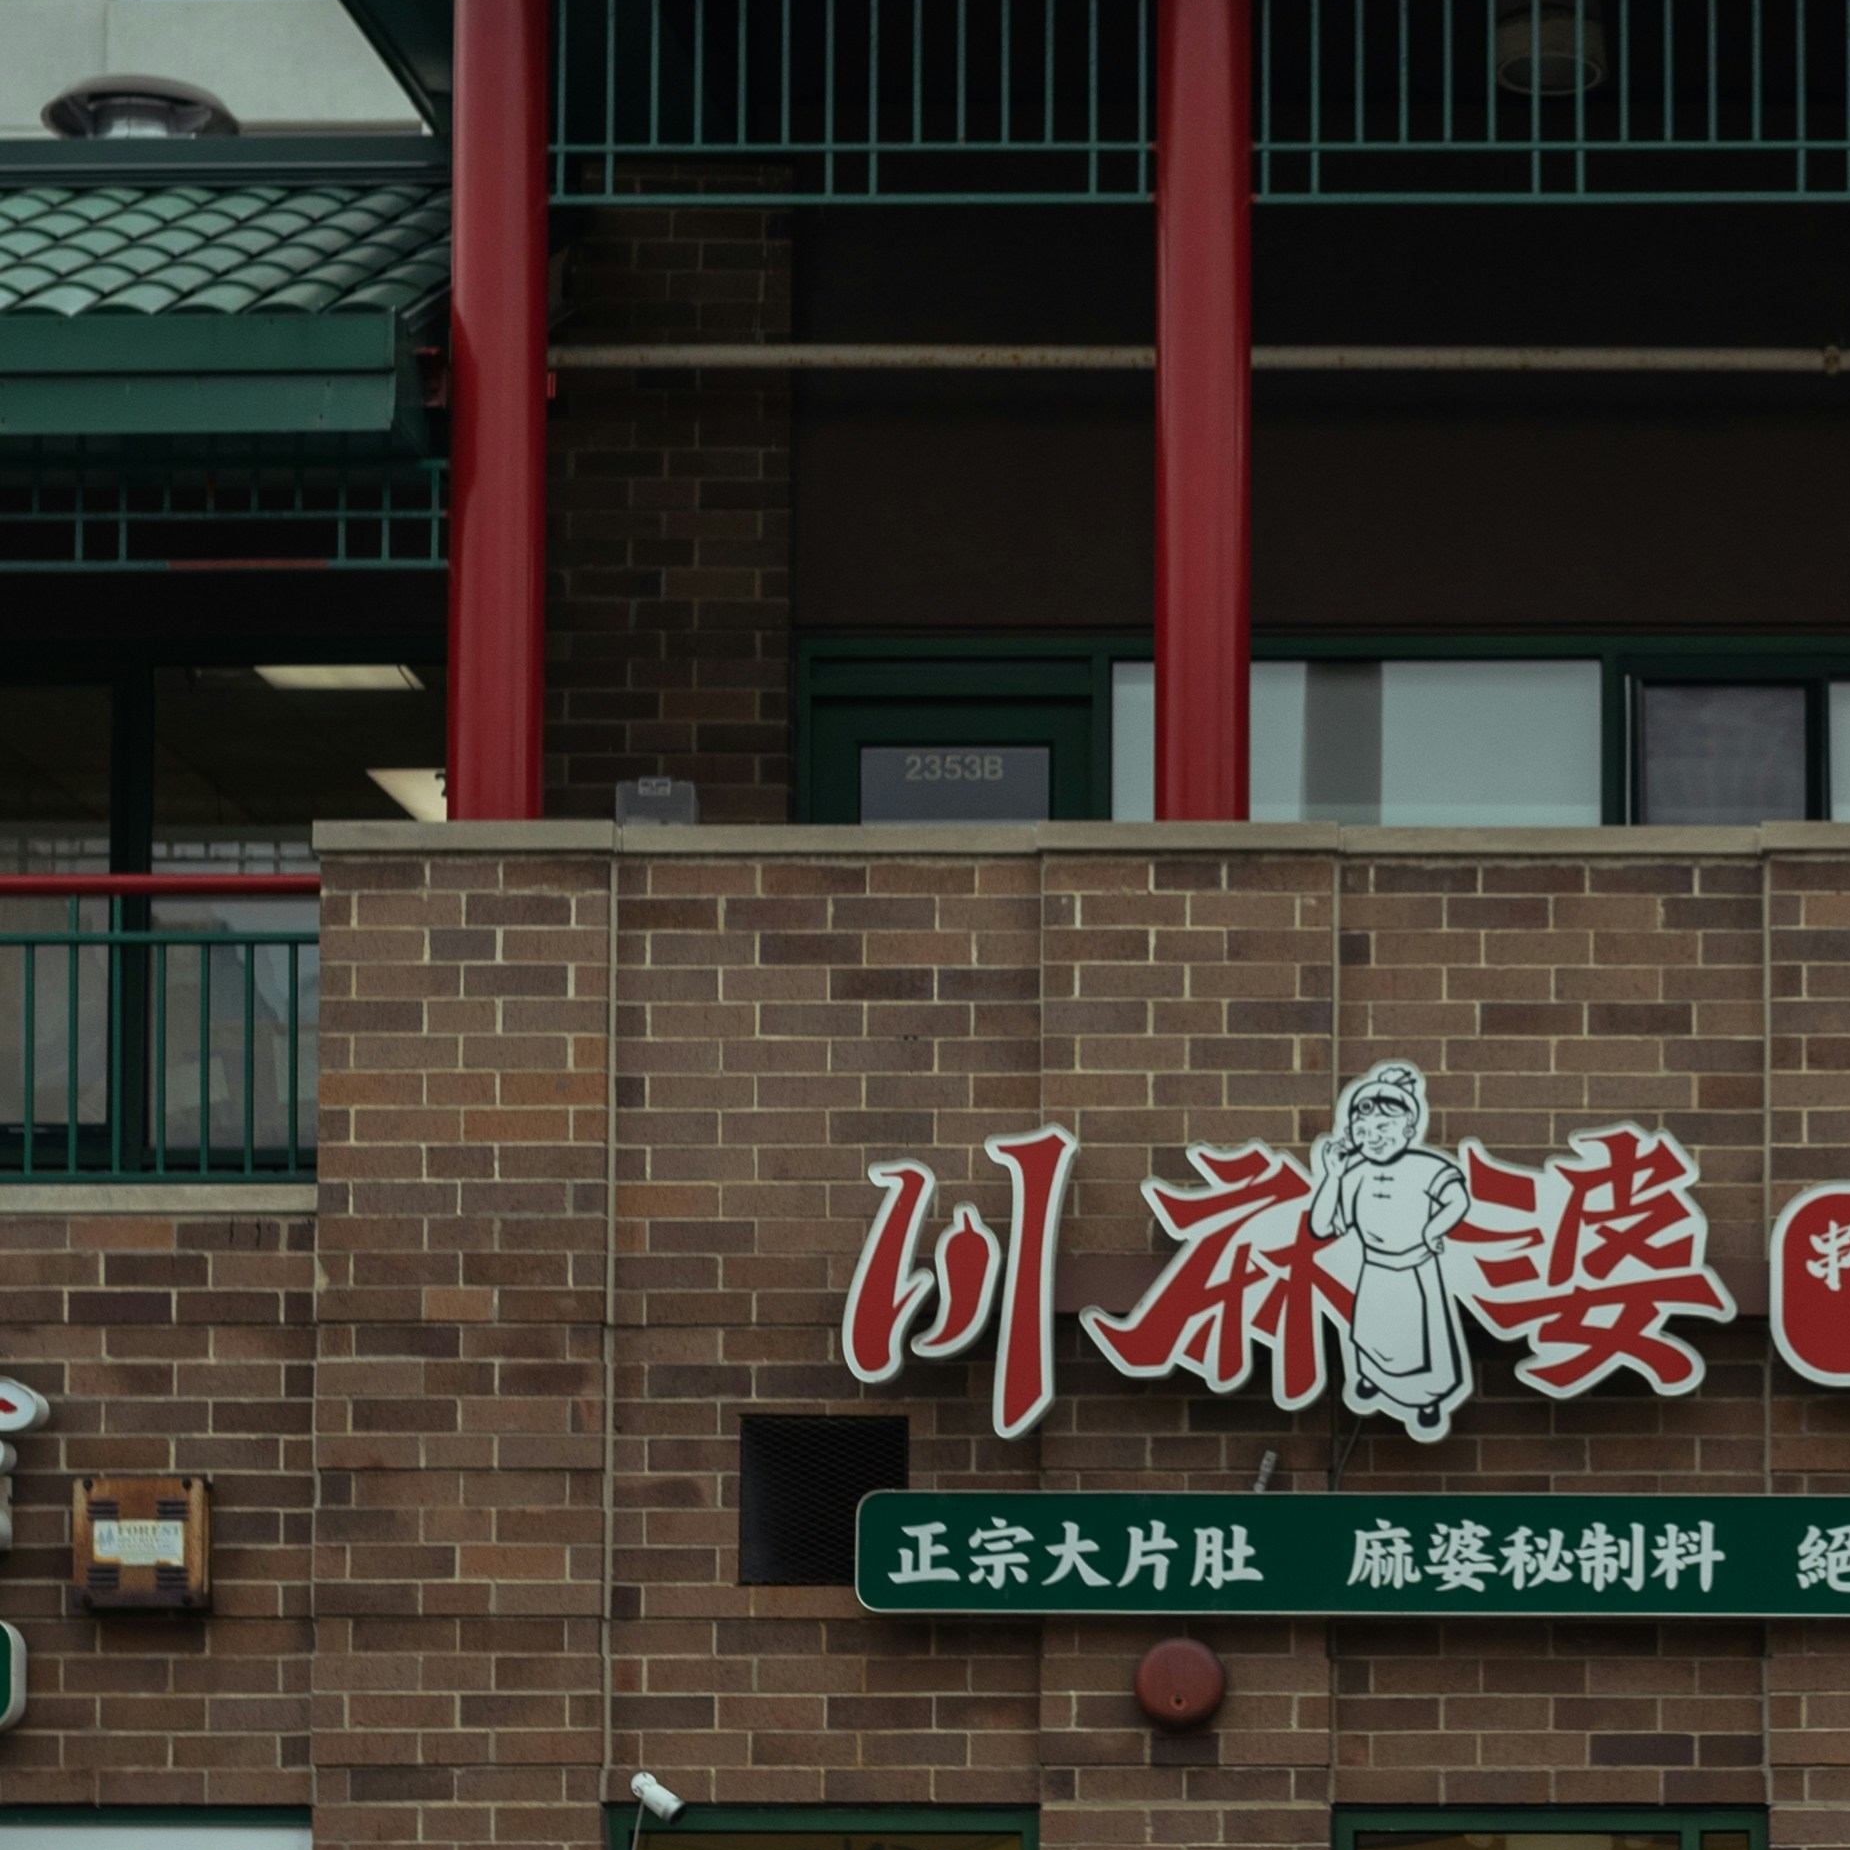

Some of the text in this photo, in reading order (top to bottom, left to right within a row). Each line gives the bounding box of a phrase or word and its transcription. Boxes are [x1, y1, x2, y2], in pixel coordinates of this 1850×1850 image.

[904, 753, 1004, 781] 2353B
[853, 1127, 1727, 1431] 川麻婆
[887, 1516, 1265, 1592] 正宗大片肚
[1345, 1517, 1727, 1593] 麻婆秘制料
